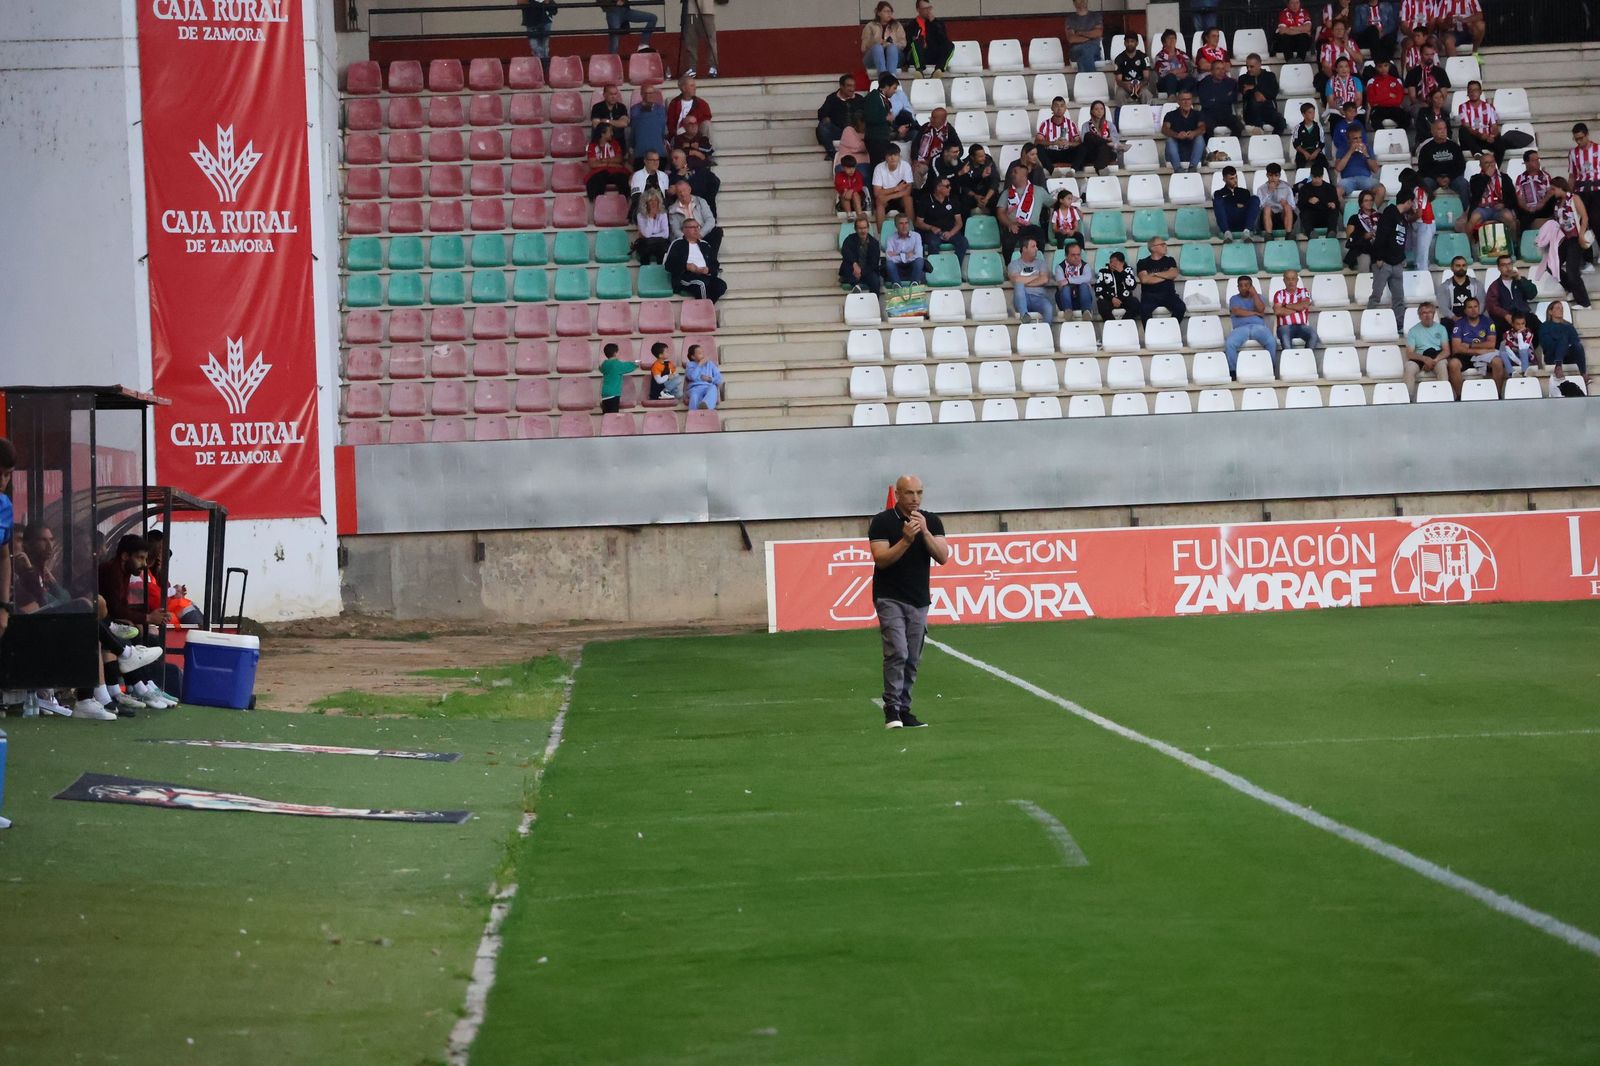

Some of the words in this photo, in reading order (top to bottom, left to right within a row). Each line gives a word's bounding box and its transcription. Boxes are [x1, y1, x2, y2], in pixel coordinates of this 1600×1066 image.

[153, 0, 208, 21] CAJA
[213, 0, 288, 22] RURAL
[178, 26, 199, 40] DE
[203, 27, 266, 42] ZAMORA
[161, 209, 216, 235] CAJA
[220, 210, 298, 234] RURAL
[186, 239, 206, 253] DE
[211, 239, 274, 253] ZAMORA
[170, 422, 226, 448] CAJA
[230, 421, 305, 446] RURAL
[195, 451, 216, 466] DE
[220, 450, 283, 465] ZAMORA
[1172, 526, 1377, 571] FUNDACIÓN
[927, 582, 1095, 622] AMORA
